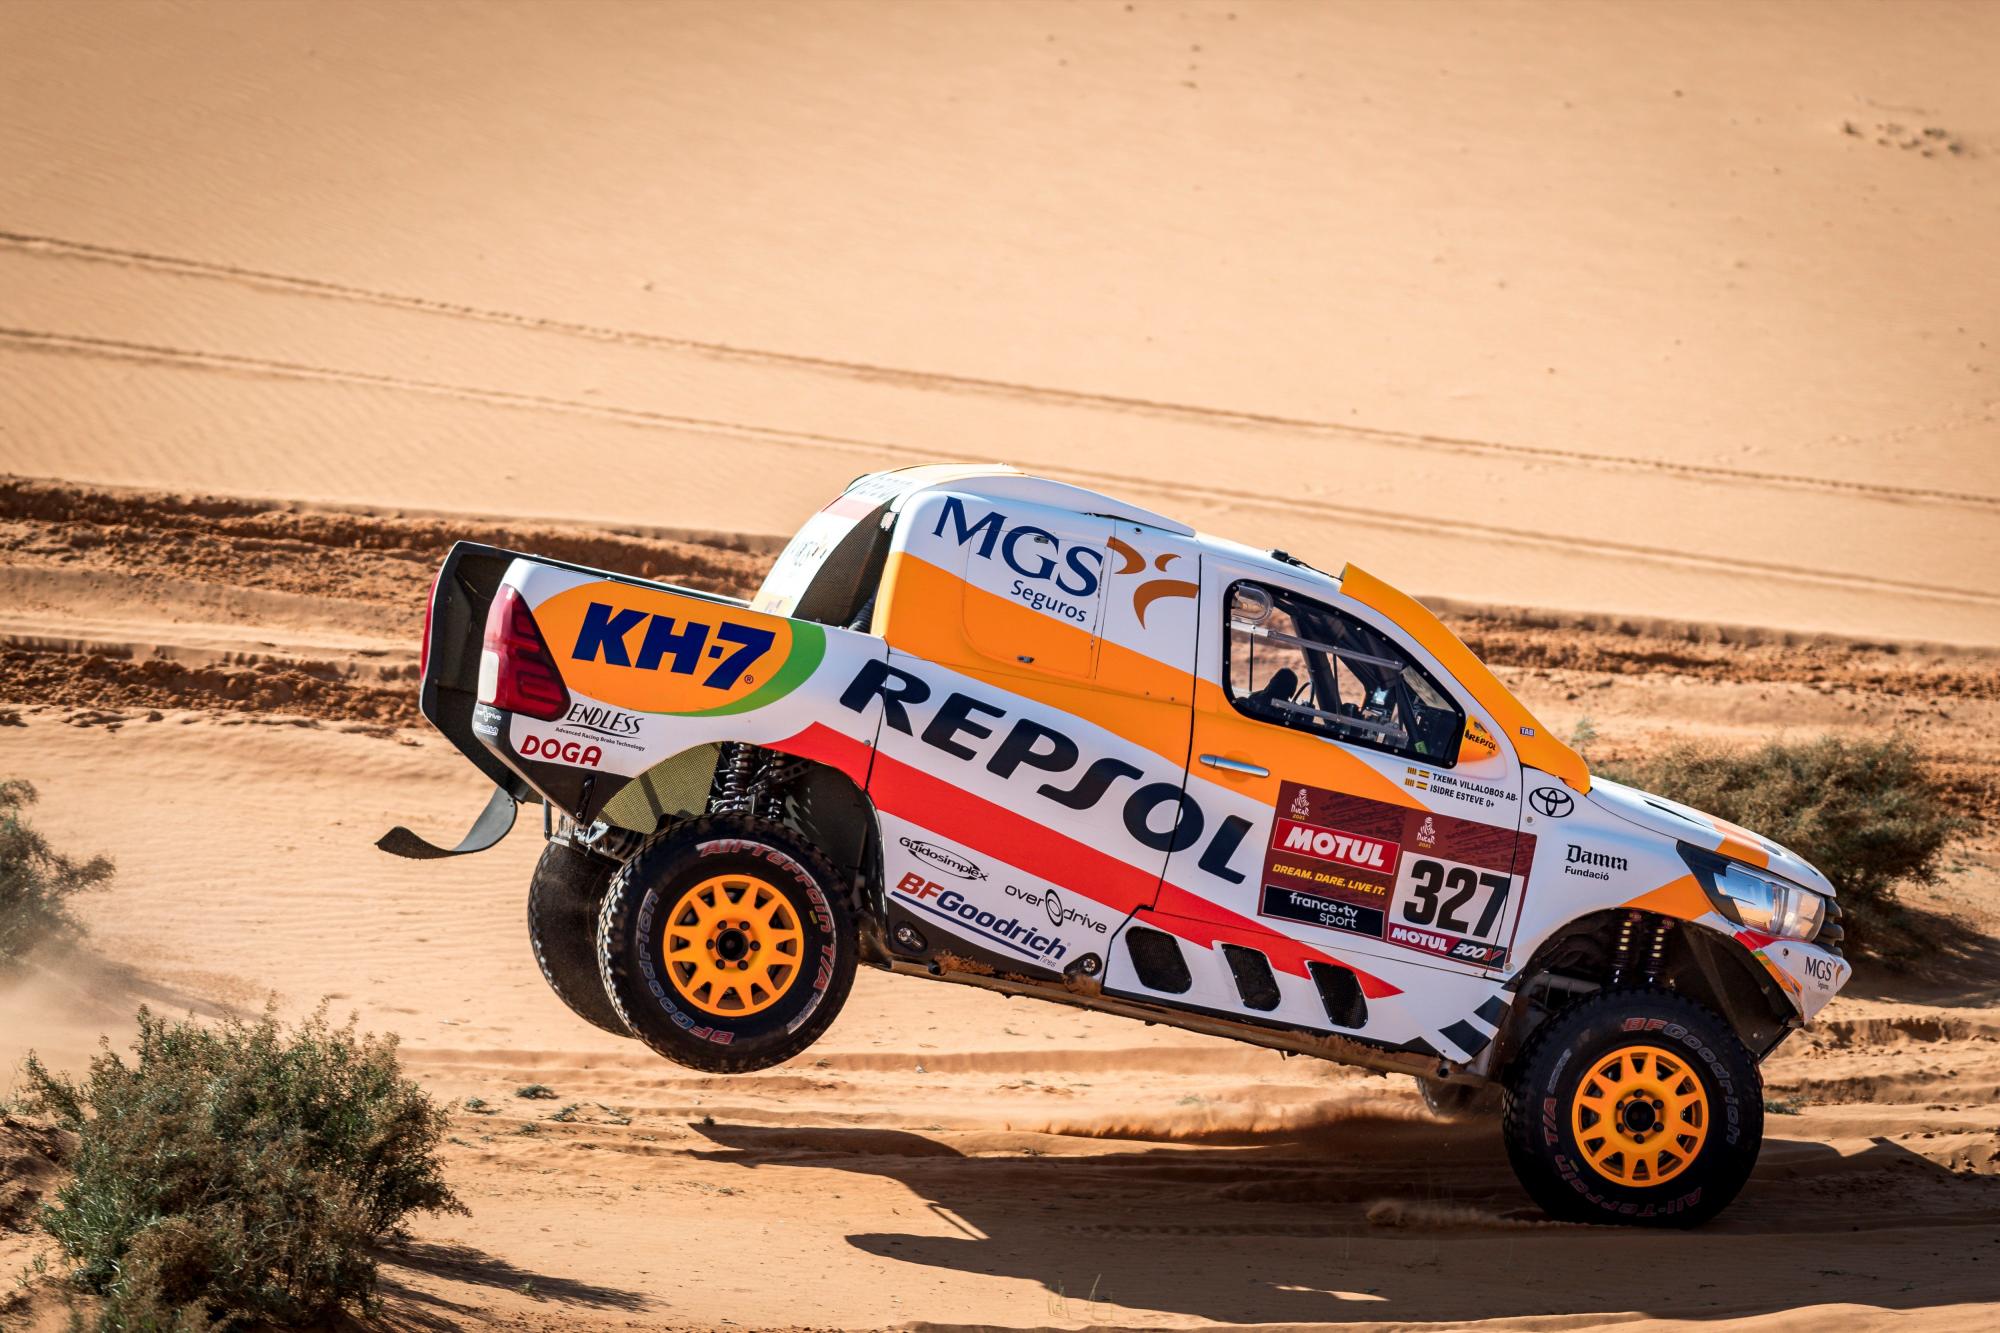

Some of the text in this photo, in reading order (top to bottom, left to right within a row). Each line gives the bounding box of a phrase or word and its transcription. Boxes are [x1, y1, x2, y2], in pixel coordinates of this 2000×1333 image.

[931, 496, 1104, 597] MGS
[1010, 580, 1087, 622] Seguros
[566, 703, 645, 735] ENDLESS
[1521, 727, 1534, 736] TAB
[520, 735, 603, 767] DOGA
[555, 726, 646, 752] Advanced Racing Brake Technology
[839, 658, 1254, 885] REPSOL
[1432, 773, 1458, 786] TXEMA
[1459, 780, 1505, 798] VILLALOBOS
[1290, 804, 1310, 817] DAKAR
[1430, 784, 1454, 798] ISIDRE
[1456, 792, 1484, 805] ESTEVE
[1284, 826, 1384, 867] MOTUL
[1416, 831, 1436, 845] DAKAR
[899, 836, 988, 882] Guidosimplex
[1564, 865, 1610, 881] Fundació
[1565, 844, 1628, 871] Damm
[1272, 864, 1386, 896] DREAM. DARE. LIVE IT.
[1403, 859, 1511, 938] 327
[896, 872, 1068, 960] BFGoodrich
[1319, 912, 1357, 929] sport
[1391, 927, 1503, 961] MOTUL 300V
[636, 888, 735, 1045] BFGoodrich
[1038, 955, 1057, 968] Tires
[1805, 956, 1832, 981] MGS
[1622, 1017, 1741, 1145] BFGoodrich
